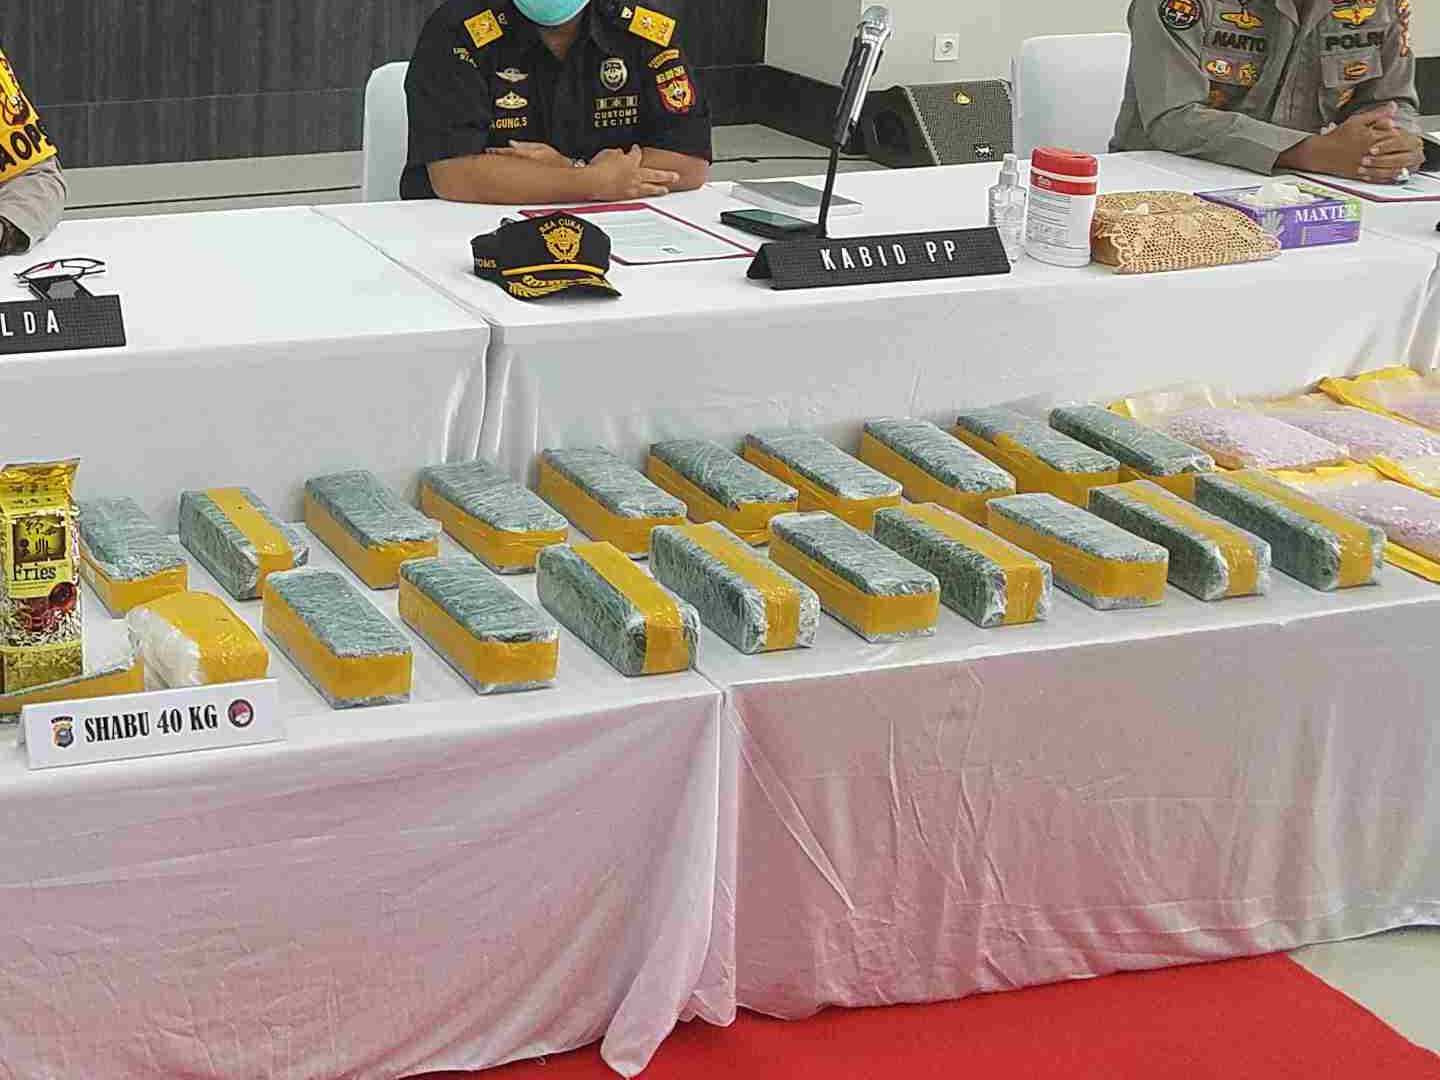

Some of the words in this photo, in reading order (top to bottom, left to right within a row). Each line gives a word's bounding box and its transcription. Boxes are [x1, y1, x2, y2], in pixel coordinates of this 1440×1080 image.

[1295, 203, 1358, 222] MAXTER
[820, 244, 906, 270] KABID
[925, 240, 956, 263] PP
[13, 563, 57, 581] Fries
[84, 711, 150, 743] SHABU
[156, 708, 182, 734] 40
[188, 704, 218, 731] KG
